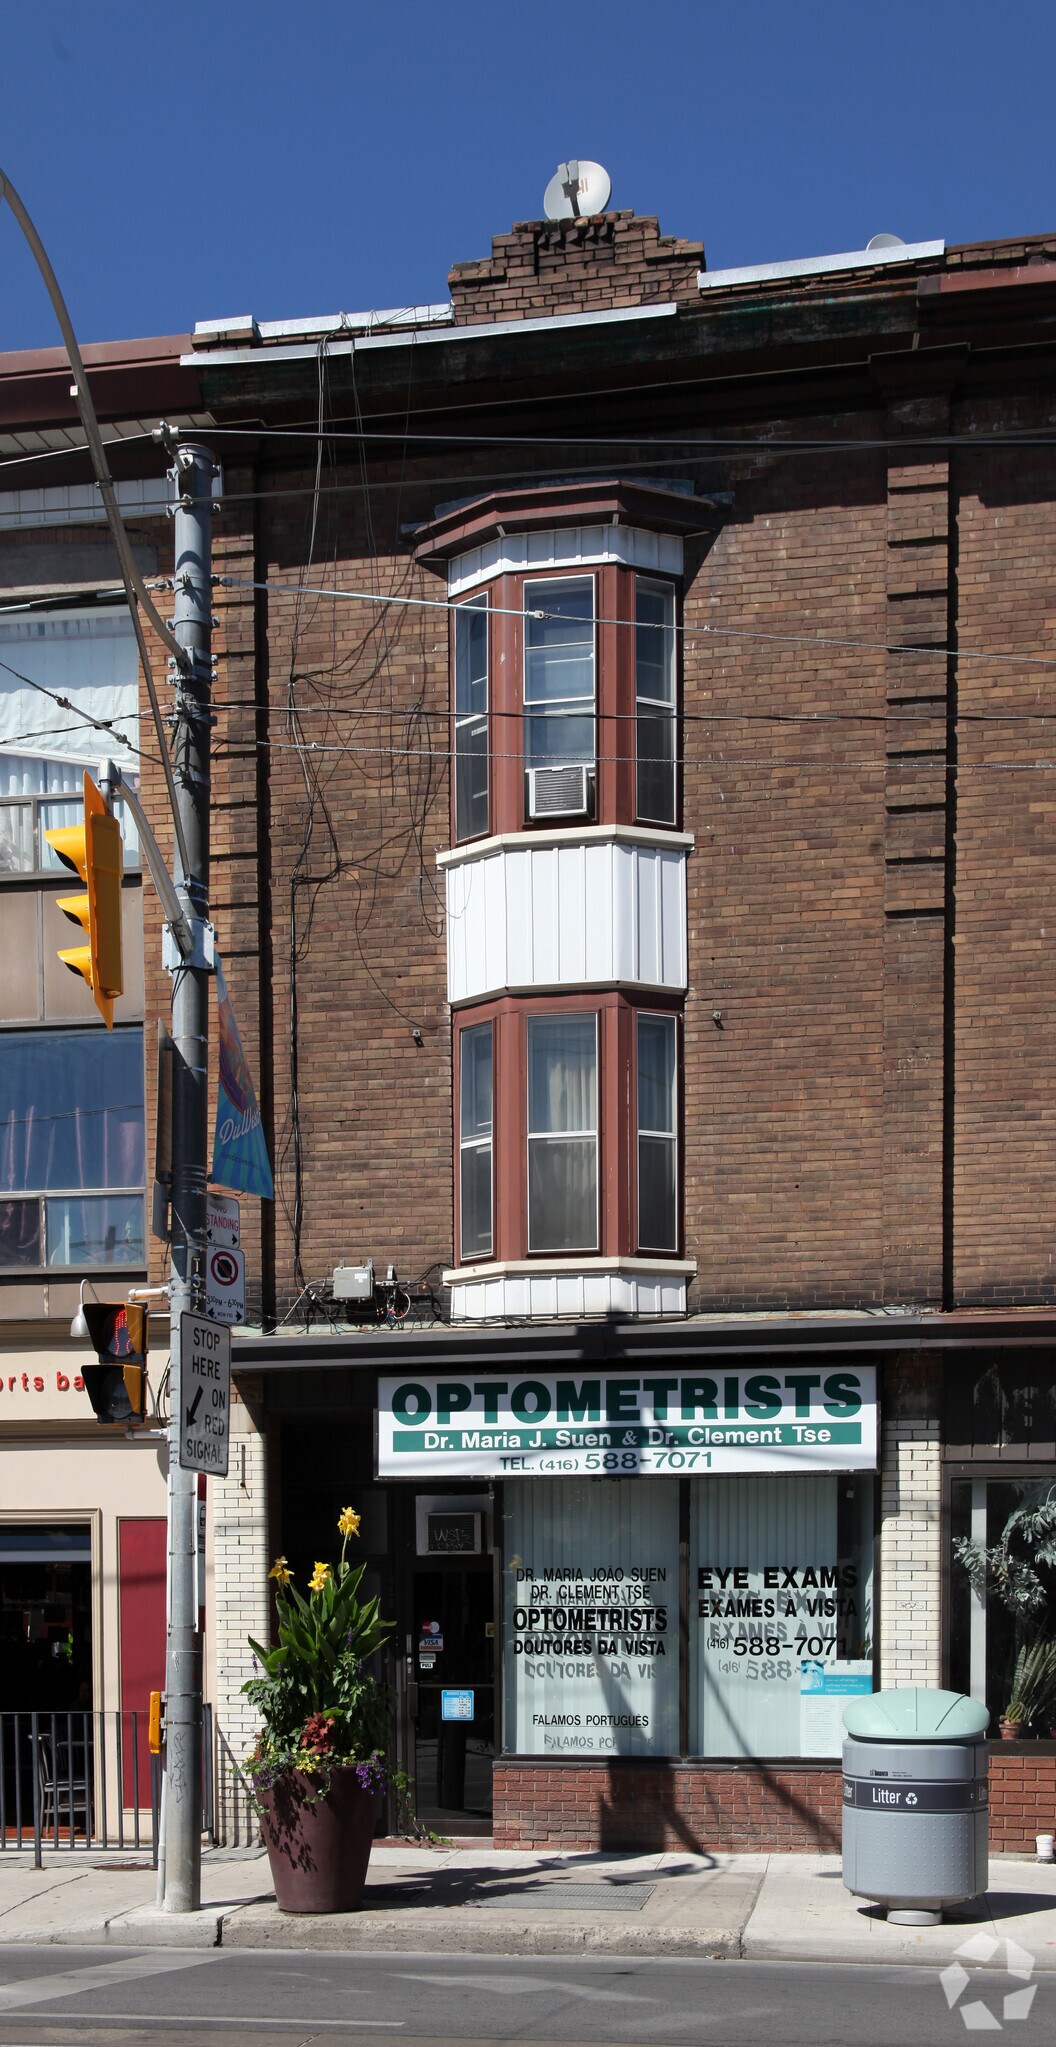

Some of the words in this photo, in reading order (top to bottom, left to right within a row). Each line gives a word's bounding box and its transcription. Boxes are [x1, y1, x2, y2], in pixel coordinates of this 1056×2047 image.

[206, 1213, 239, 1232] STANDING
[193, 1328, 221, 1352] STOP
[192, 1354, 221, 1380] HERE
[211, 1388, 226, 1410] ON
[391, 1373, 862, 1426] OPTOMETRISTS
[204, 1414, 225, 1436] RED
[424, 1432, 454, 1449] Dr.
[461, 1431, 521, 1448] Maria
[528, 1431, 547, 1448] J.
[555, 1430, 611, 1447] Suen
[622, 1429, 638, 1446] &
[648, 1428, 679, 1445] Dr.
[687, 1426, 782, 1444] Clement
[791, 1425, 831, 1443] Tse
[186, 1440, 223, 1464] SIGNAL
[499, 1457, 535, 1471] TEL.
[539, 1458, 579, 1471] (416)
[584, 1451, 712, 1470] 588-7071
[516, 1568, 538, 1582] DR.
[543, 1568, 584, 1582] MARIA
[589, 1565, 624, 1582] JOÃO
[631, 1567, 666, 1582] SUEN
[697, 1567, 749, 1589] EYE
[763, 1565, 858, 1589] EXAMS
[531, 1585, 552, 1599] DR.
[558, 1585, 620, 1599] CLEMENT
[626, 1585, 650, 1599] TSE
[698, 1598, 775, 1618] EXAMES
[784, 1595, 797, 1618] À
[807, 1598, 858, 1618] VISTA
[513, 1608, 668, 1631] OPTOMETRISTS
[514, 1640, 592, 1655] DOUTORES
[598, 1640, 618, 1655] DA
[626, 1640, 666, 1655] VISTA
[707, 1637, 729, 1650] (416)
[733, 1637, 847, 1656] 588-7071
[533, 1715, 581, 1726] FALAMOS
[872, 1787, 902, 1804] Litter
